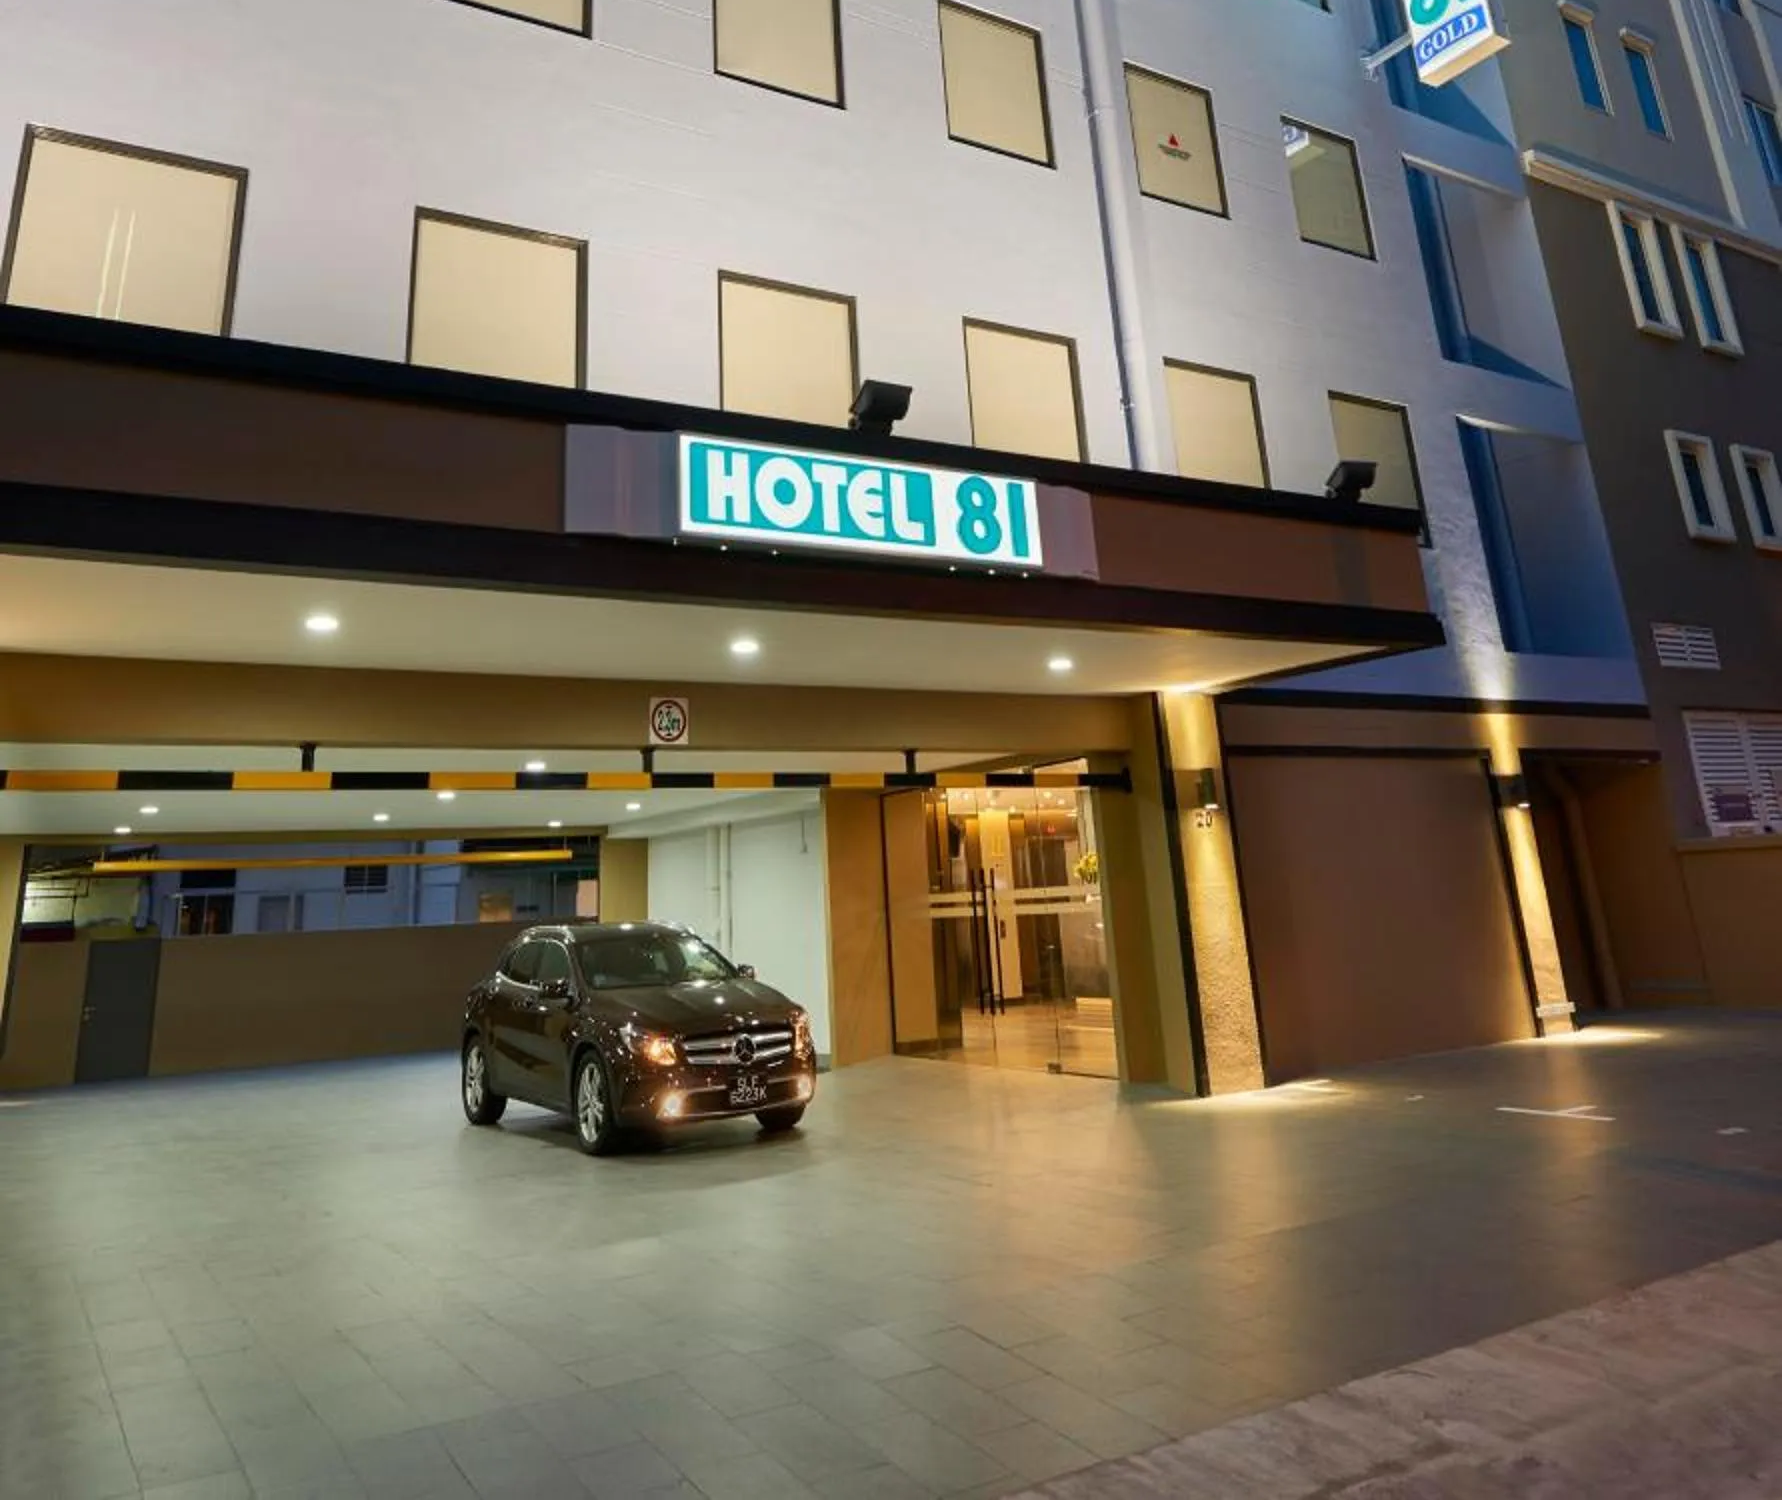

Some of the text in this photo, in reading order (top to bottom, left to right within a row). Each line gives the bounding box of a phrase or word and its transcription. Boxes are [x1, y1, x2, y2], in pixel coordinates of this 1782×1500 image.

[1420, 13, 1478, 60] GOLD
[706, 449, 1030, 558] HOTEL 81
